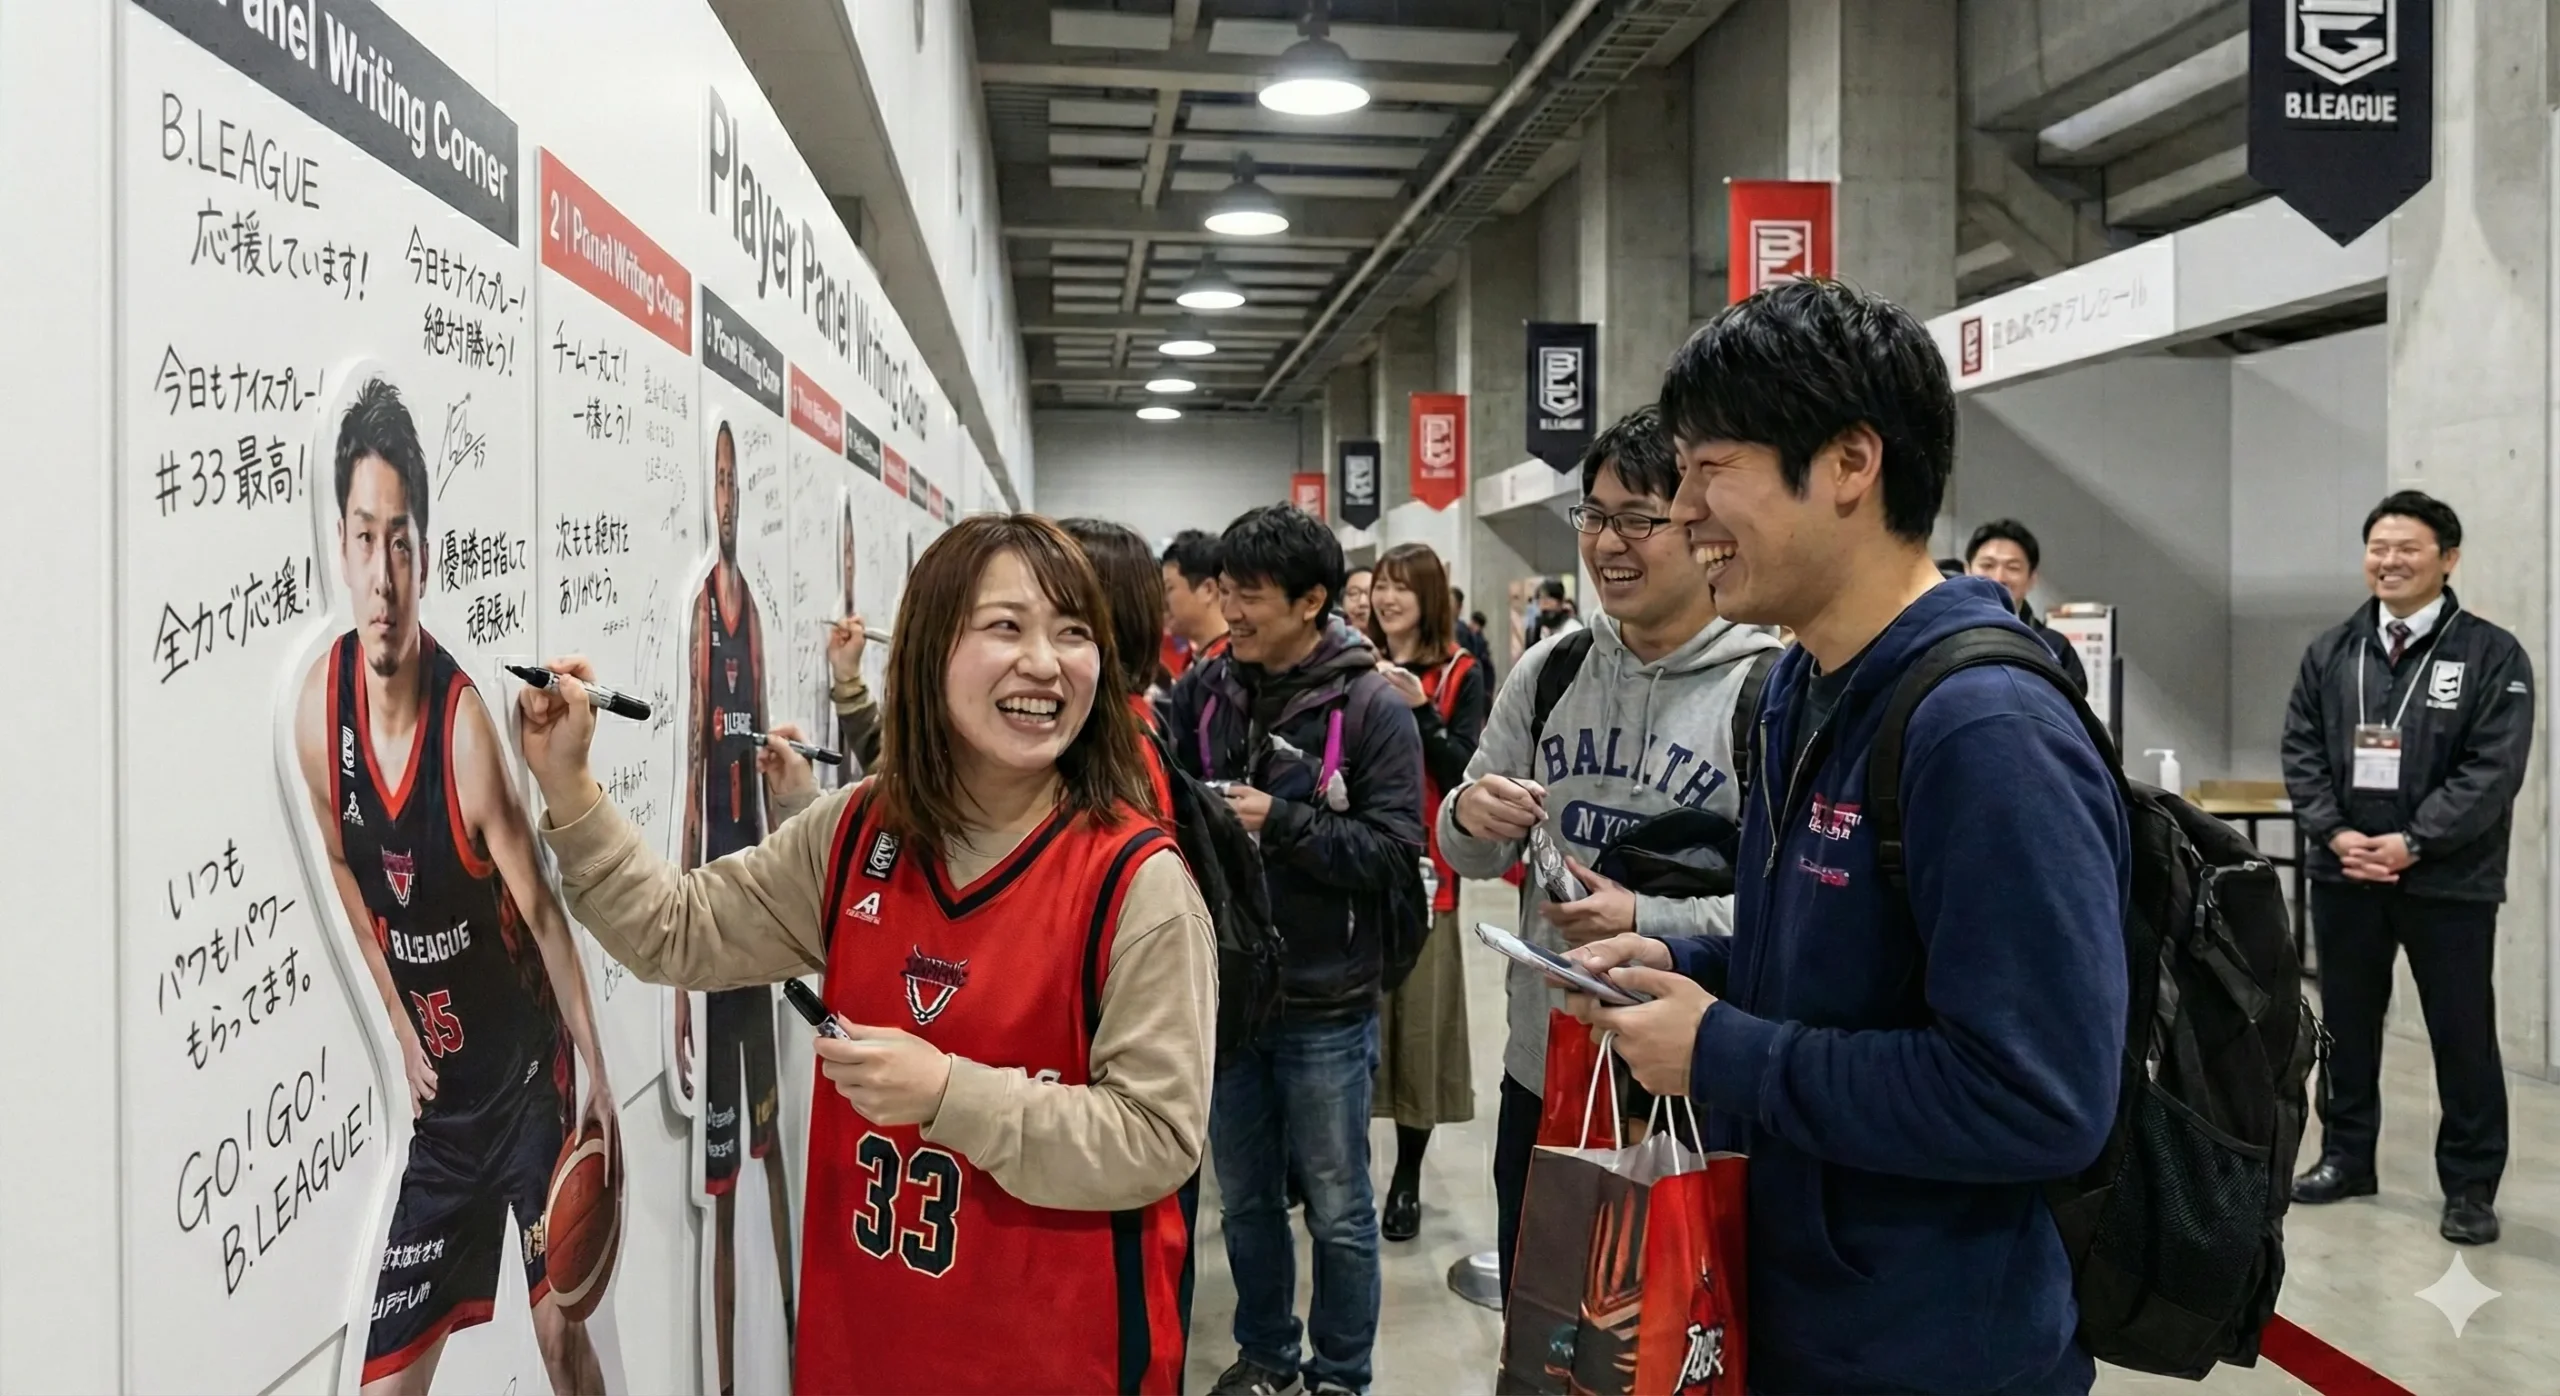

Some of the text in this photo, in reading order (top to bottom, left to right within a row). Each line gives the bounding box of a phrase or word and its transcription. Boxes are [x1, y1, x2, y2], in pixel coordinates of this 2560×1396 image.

[217, 0, 316, 69] anel
[325, 11, 426, 158] Writing
[2285, 91, 2398, 122] B.LEAGUE
[162, 91, 320, 210] B.LEAGUE
[191, 198, 369, 301] 応援しています!
[405, 224, 526, 323] 今日もナイスプレー!
[550, 189, 560, 241] 2
[709, 85, 796, 300] Player
[802, 218, 850, 364] Panel
[154, 343, 325, 416] 今日もナイスプレー!
[153, 555, 312, 684] 全力で応援!
[168, 837, 245, 920] いつも
[186, 947, 311, 1070] もらってます。
[178, 1046, 326, 1233] GO! GO!
[222, 1086, 374, 1300] B.LEAGUE!
[852, 1130, 964, 1279] 33
